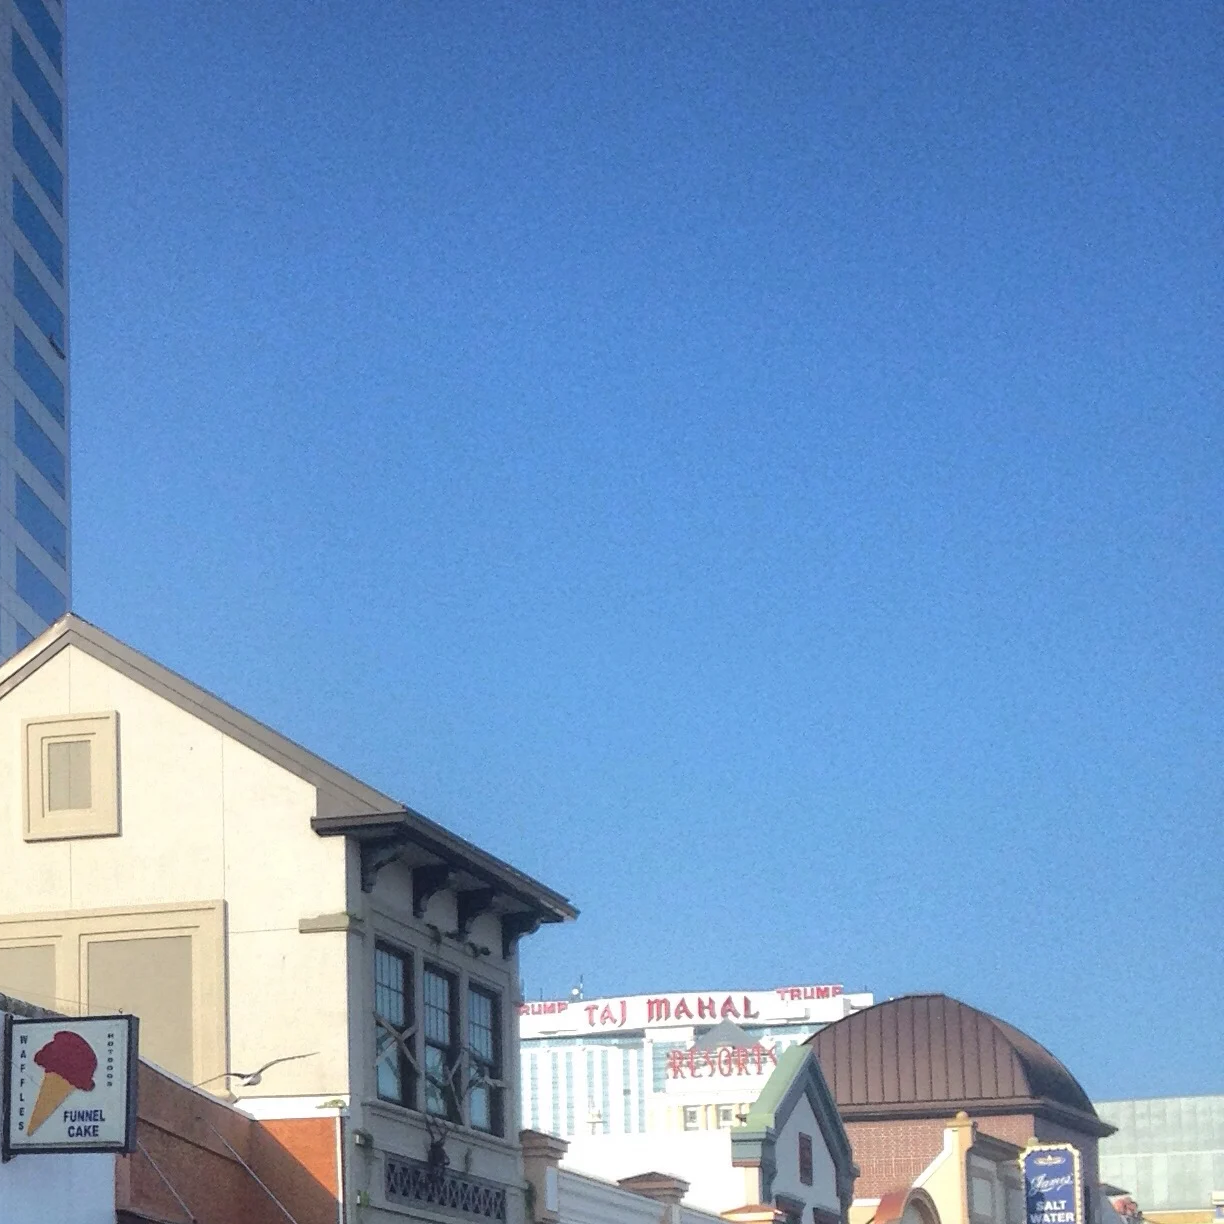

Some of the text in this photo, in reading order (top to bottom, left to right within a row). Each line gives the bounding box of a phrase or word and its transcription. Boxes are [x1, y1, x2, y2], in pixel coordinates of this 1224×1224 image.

[776, 984, 843, 1001] TRUMP
[583, 995, 760, 1030] TAJ MAHAL
[18, 1035, 28, 1131] WAFFLES
[63, 1109, 106, 1124] FUNNEL
[67, 1125, 100, 1138] CAKE
[1036, 1200, 1067, 1211] SALT
[1030, 1212, 1075, 1223] WATER
